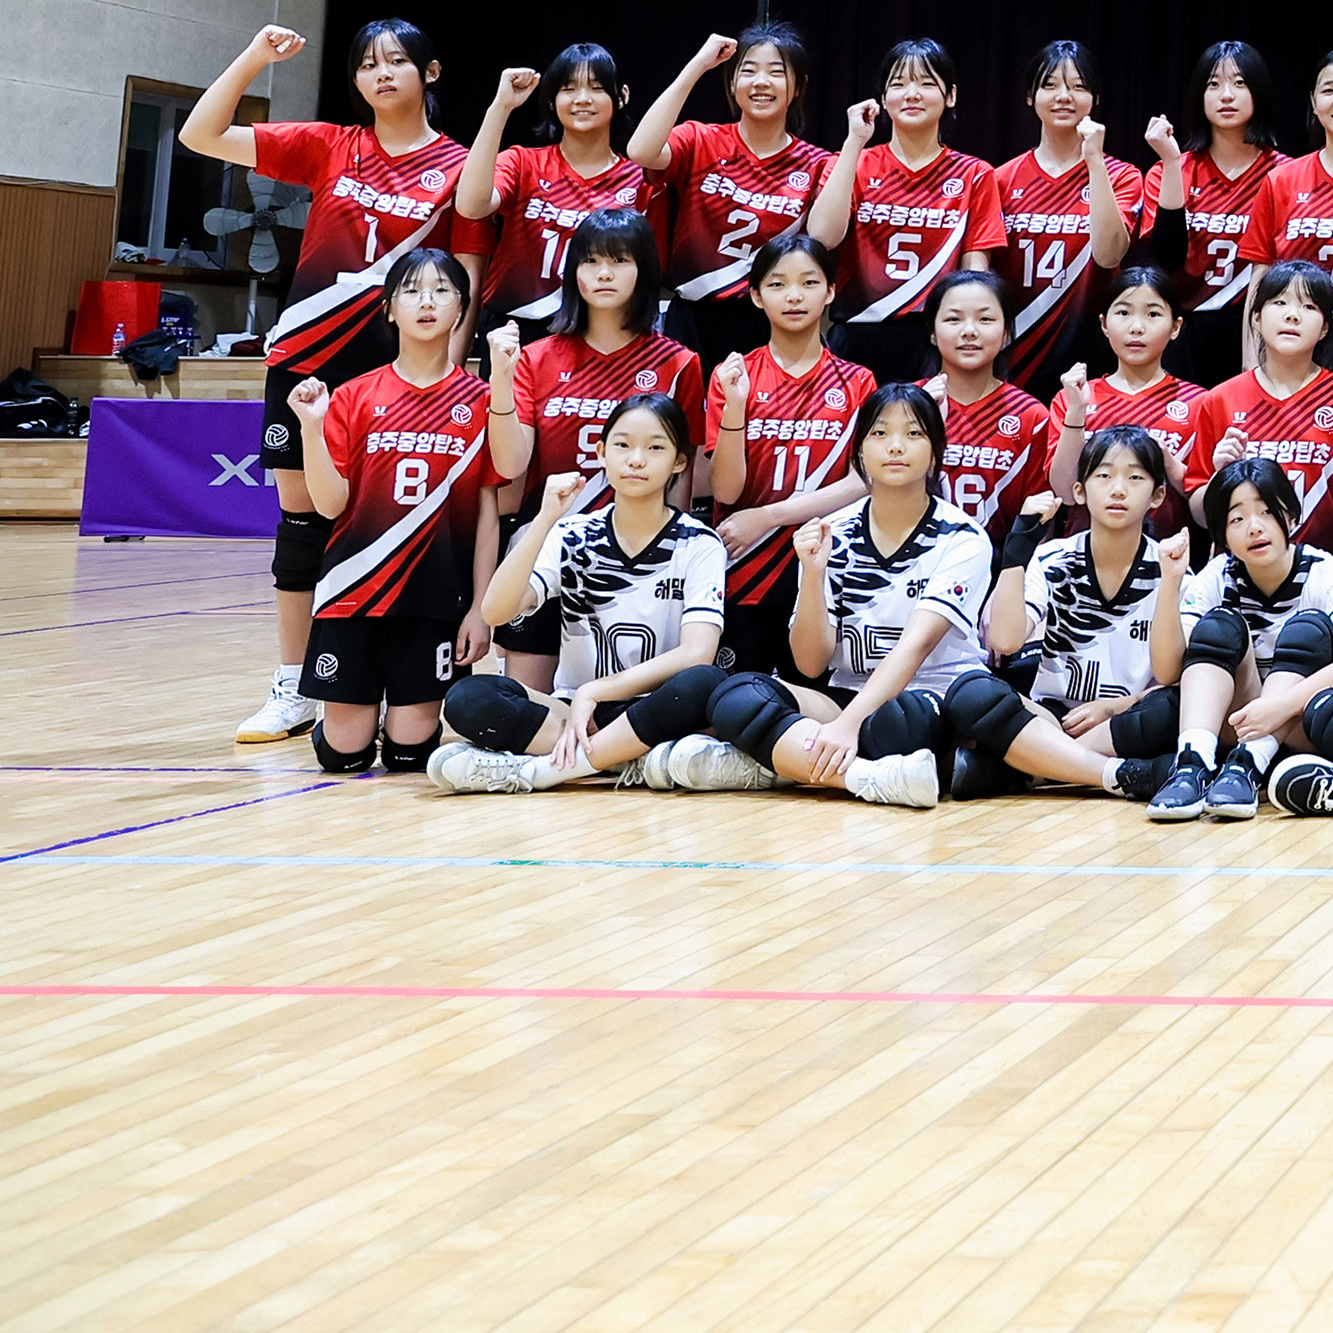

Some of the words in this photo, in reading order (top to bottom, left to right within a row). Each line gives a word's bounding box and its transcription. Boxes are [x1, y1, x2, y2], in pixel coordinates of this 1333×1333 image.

[701, 174, 806, 218] 충주중앙탑초
[857, 202, 961, 230] 충주중앙탑초
[364, 213, 380, 263] 1
[717, 208, 760, 262] 2
[885, 232, 922, 281] 5
[1018, 238, 1067, 290] 14
[1204, 238, 1238, 287] 3
[366, 430, 467, 458] 충주중앙탑초
[747, 418, 844, 442] 충주중앙탑초
[393, 458, 430, 507] 8
[773, 445, 811, 492] 11
[655, 578, 685, 601] 해밀
[436, 641, 454, 682] 8
